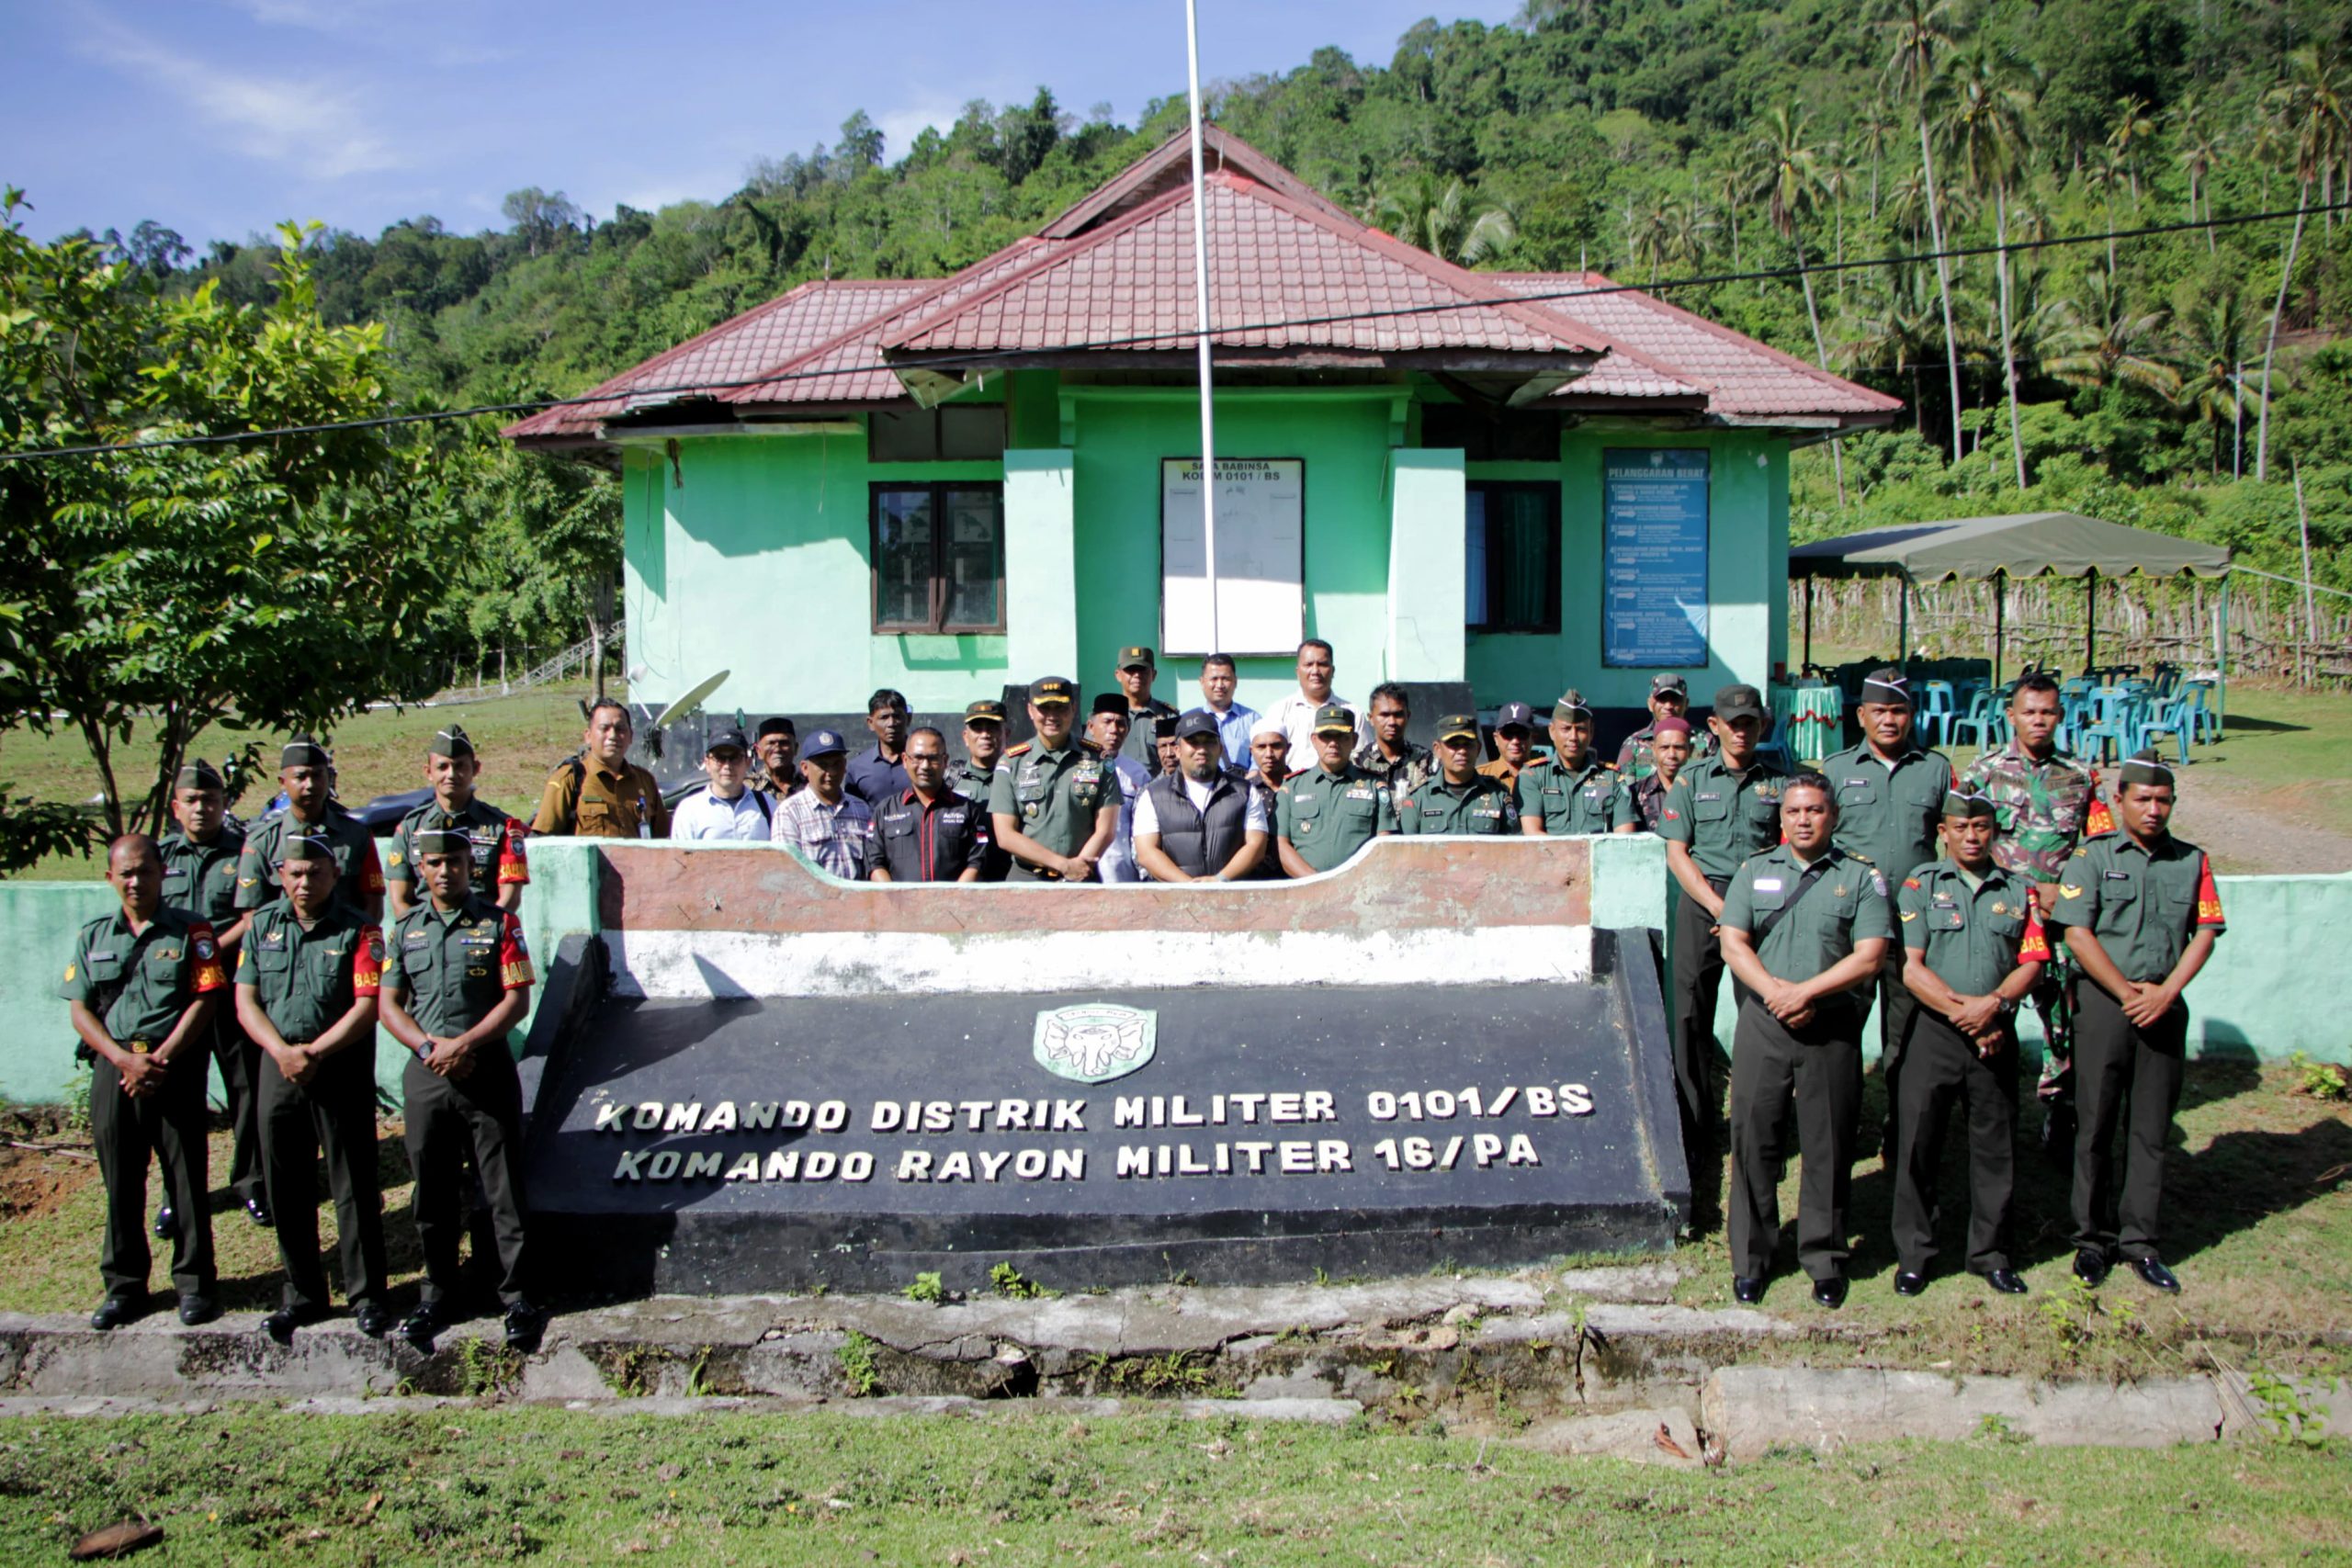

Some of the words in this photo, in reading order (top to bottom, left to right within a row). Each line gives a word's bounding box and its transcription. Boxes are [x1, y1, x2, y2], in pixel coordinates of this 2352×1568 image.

[1222, 462, 1270, 470] BABINSA
[1226, 472, 1253, 480] 0101
[1264, 472, 1280, 480] BS
[594, 1100, 849, 1133] KOMANDO
[871, 1099, 1087, 1133] DISTRIK
[1114, 1090, 1337, 1128] MILITER
[1368, 1083, 1594, 1121] 0101/BS
[614, 1150, 873, 1181] KOMANDO
[898, 1148, 1083, 1181] RAYON
[1116, 1139, 1352, 1179] MILITER
[1374, 1134, 1542, 1171] 16/PA
